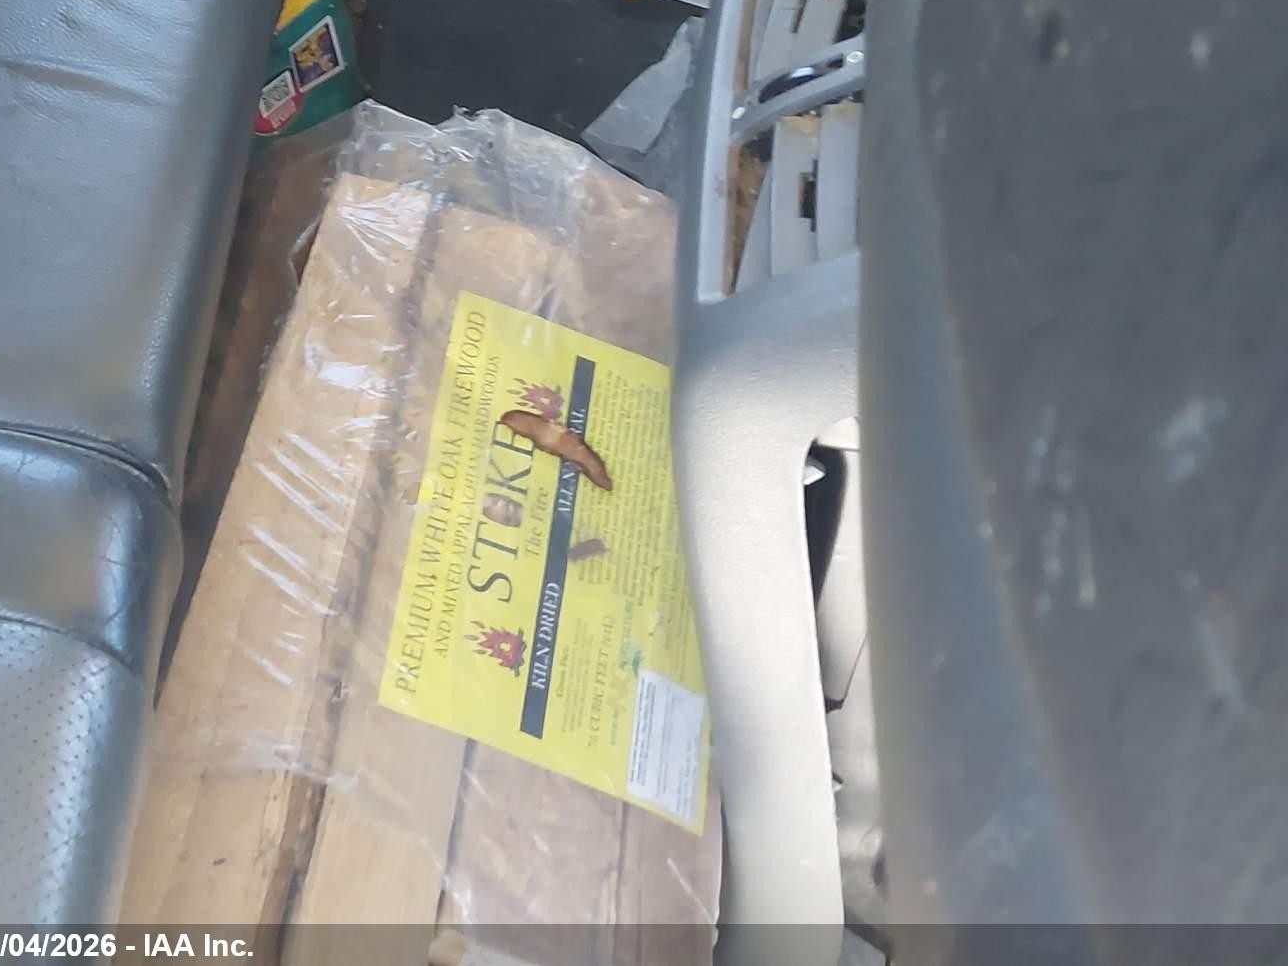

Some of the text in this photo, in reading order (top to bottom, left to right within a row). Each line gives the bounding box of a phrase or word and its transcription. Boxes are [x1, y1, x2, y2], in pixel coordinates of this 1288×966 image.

[471, 354, 501, 448] HARDWOODS
[395, 310, 487, 694] PREMIUM WHITE OAK FIREWOOD
[525, 486, 549, 557] The Fire
[441, 562, 463, 618] MIXED
[537, 582, 561, 642] DRIED
[434, 620, 452, 658] AND
[531, 643, 551, 690] KILN
[595, 648, 610, 686] FEET
